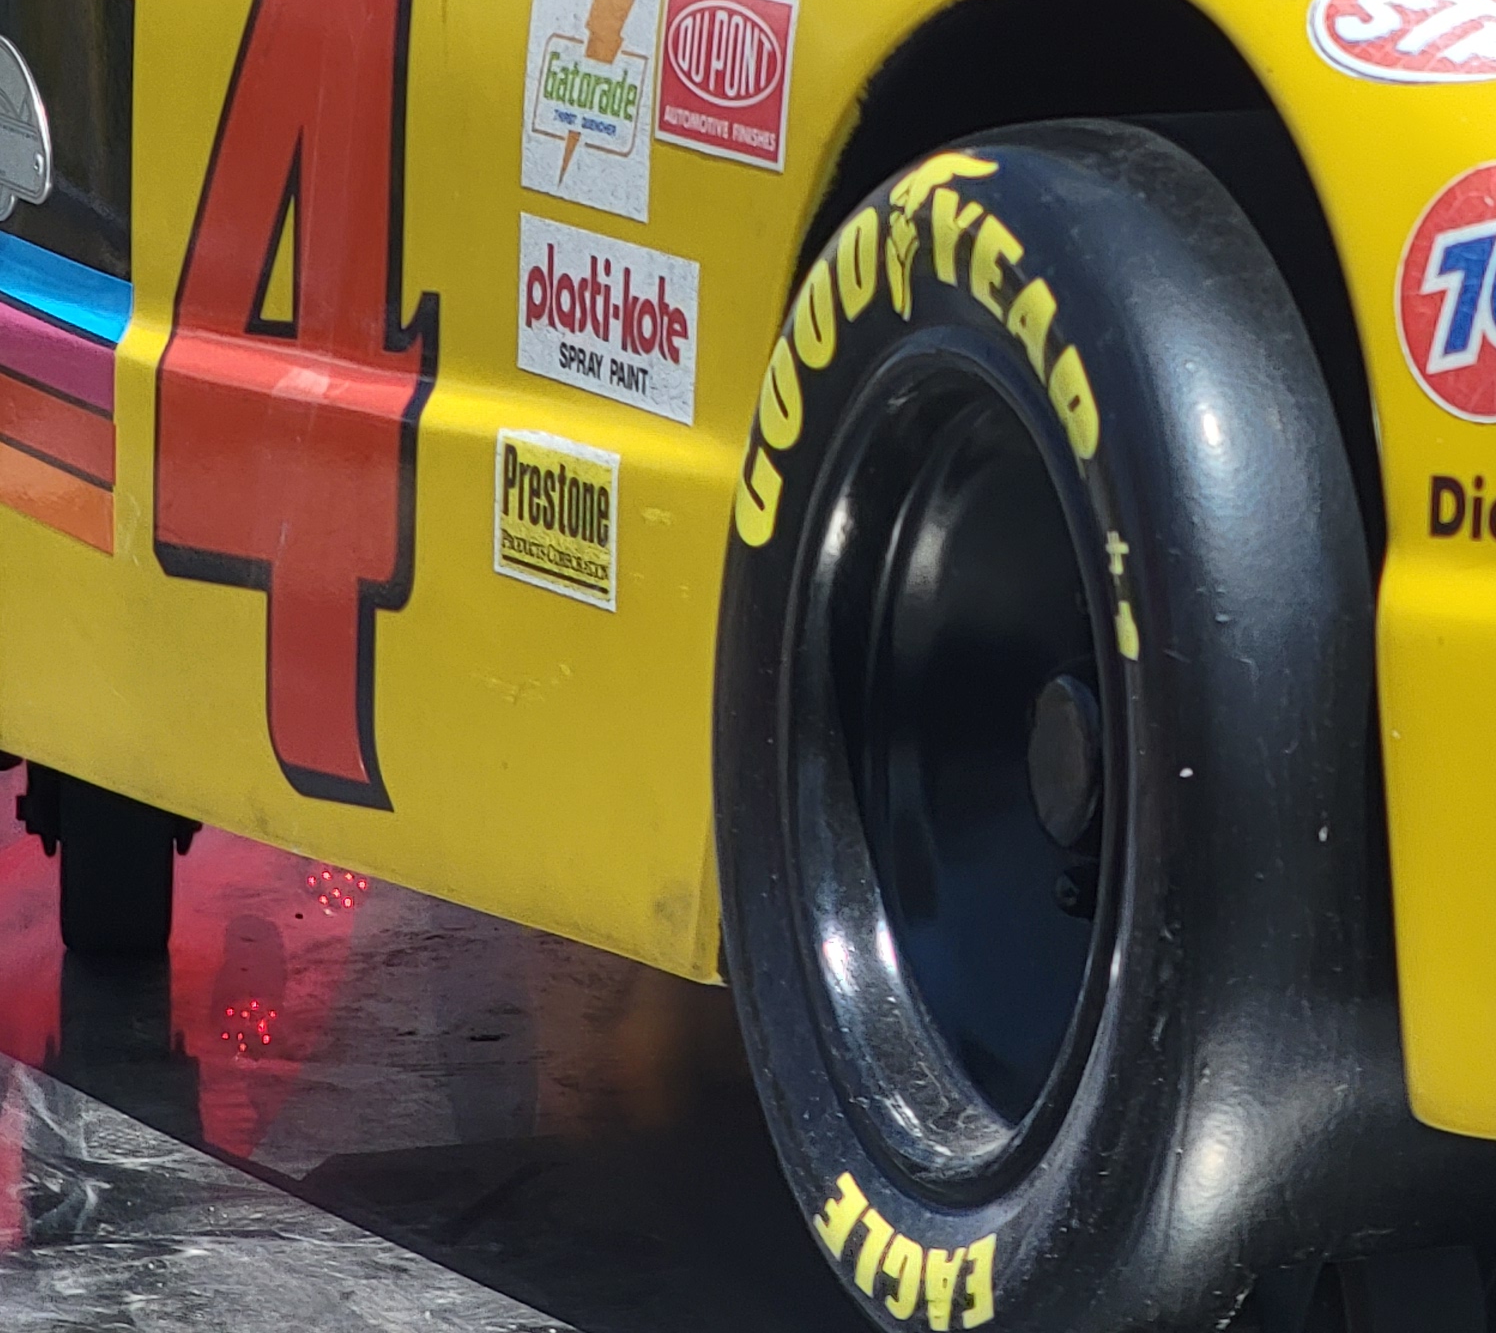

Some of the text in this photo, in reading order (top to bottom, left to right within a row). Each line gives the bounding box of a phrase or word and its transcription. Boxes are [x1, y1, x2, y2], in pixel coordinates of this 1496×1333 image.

[543, 50, 638, 123] Gatorade
[525, 242, 689, 366] plasti-kote
[558, 341, 649, 396] SPRAY PAINT
[502, 443, 610, 549] Prestone
[812, 1170, 998, 1332] EAGLE
